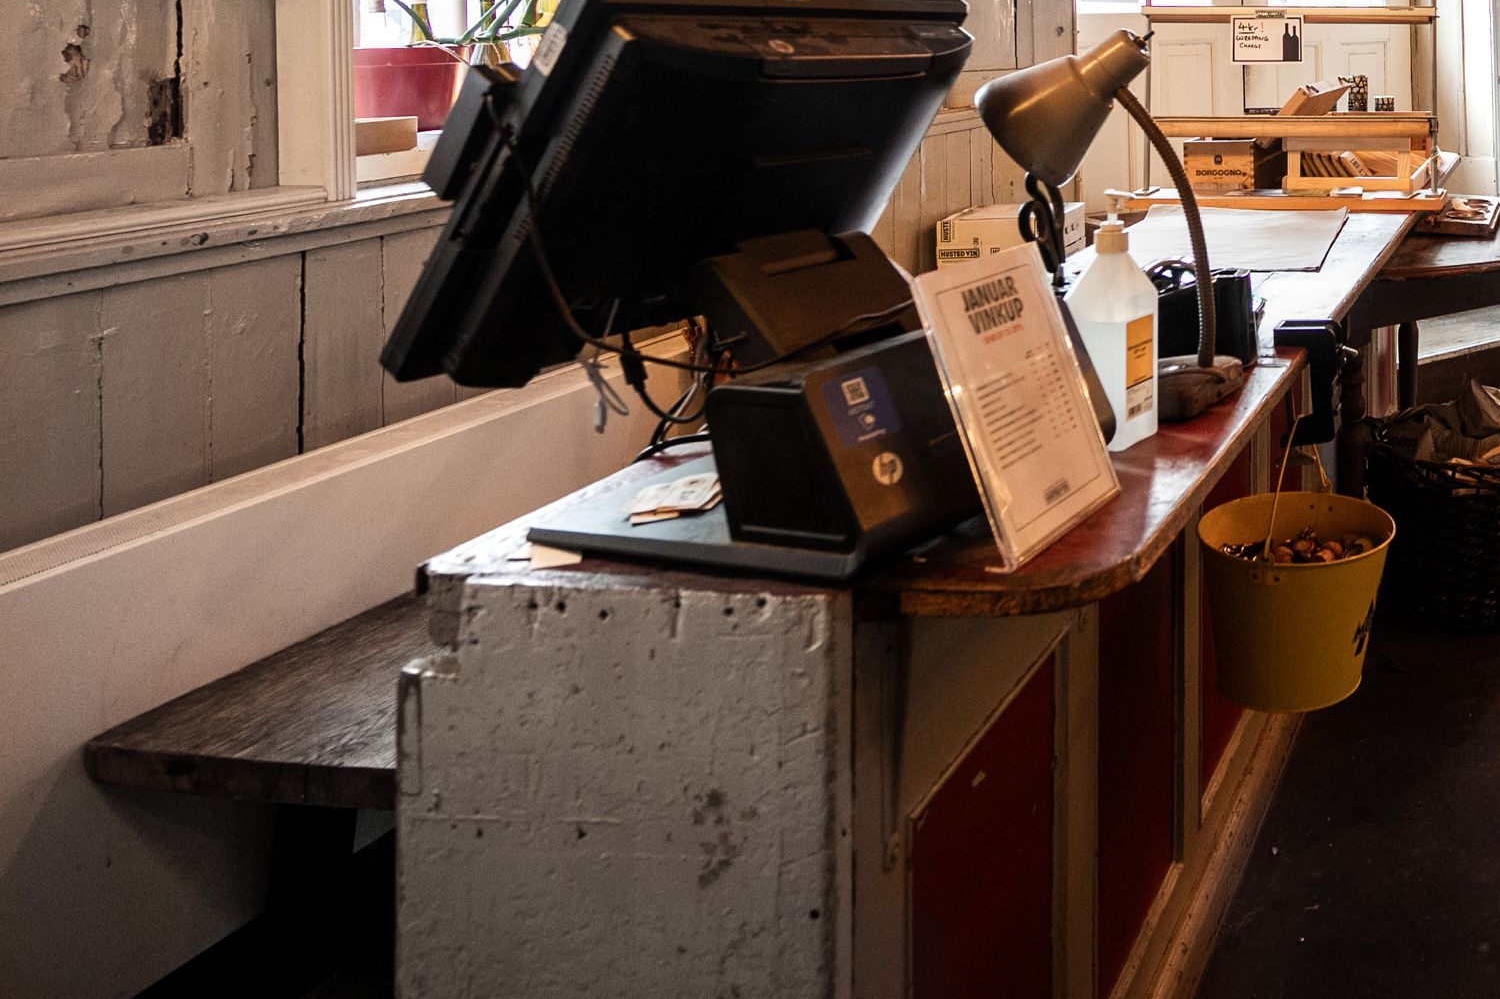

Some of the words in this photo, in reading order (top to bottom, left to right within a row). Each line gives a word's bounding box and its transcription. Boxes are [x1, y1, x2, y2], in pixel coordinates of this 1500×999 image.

[1195, 169, 1242, 177] BORGOGNO
[941, 249, 965, 258] HUSTED
[966, 249, 978, 257] VIN
[961, 275, 1020, 313] JANUAR
[967, 297, 1024, 335] VINKUP
